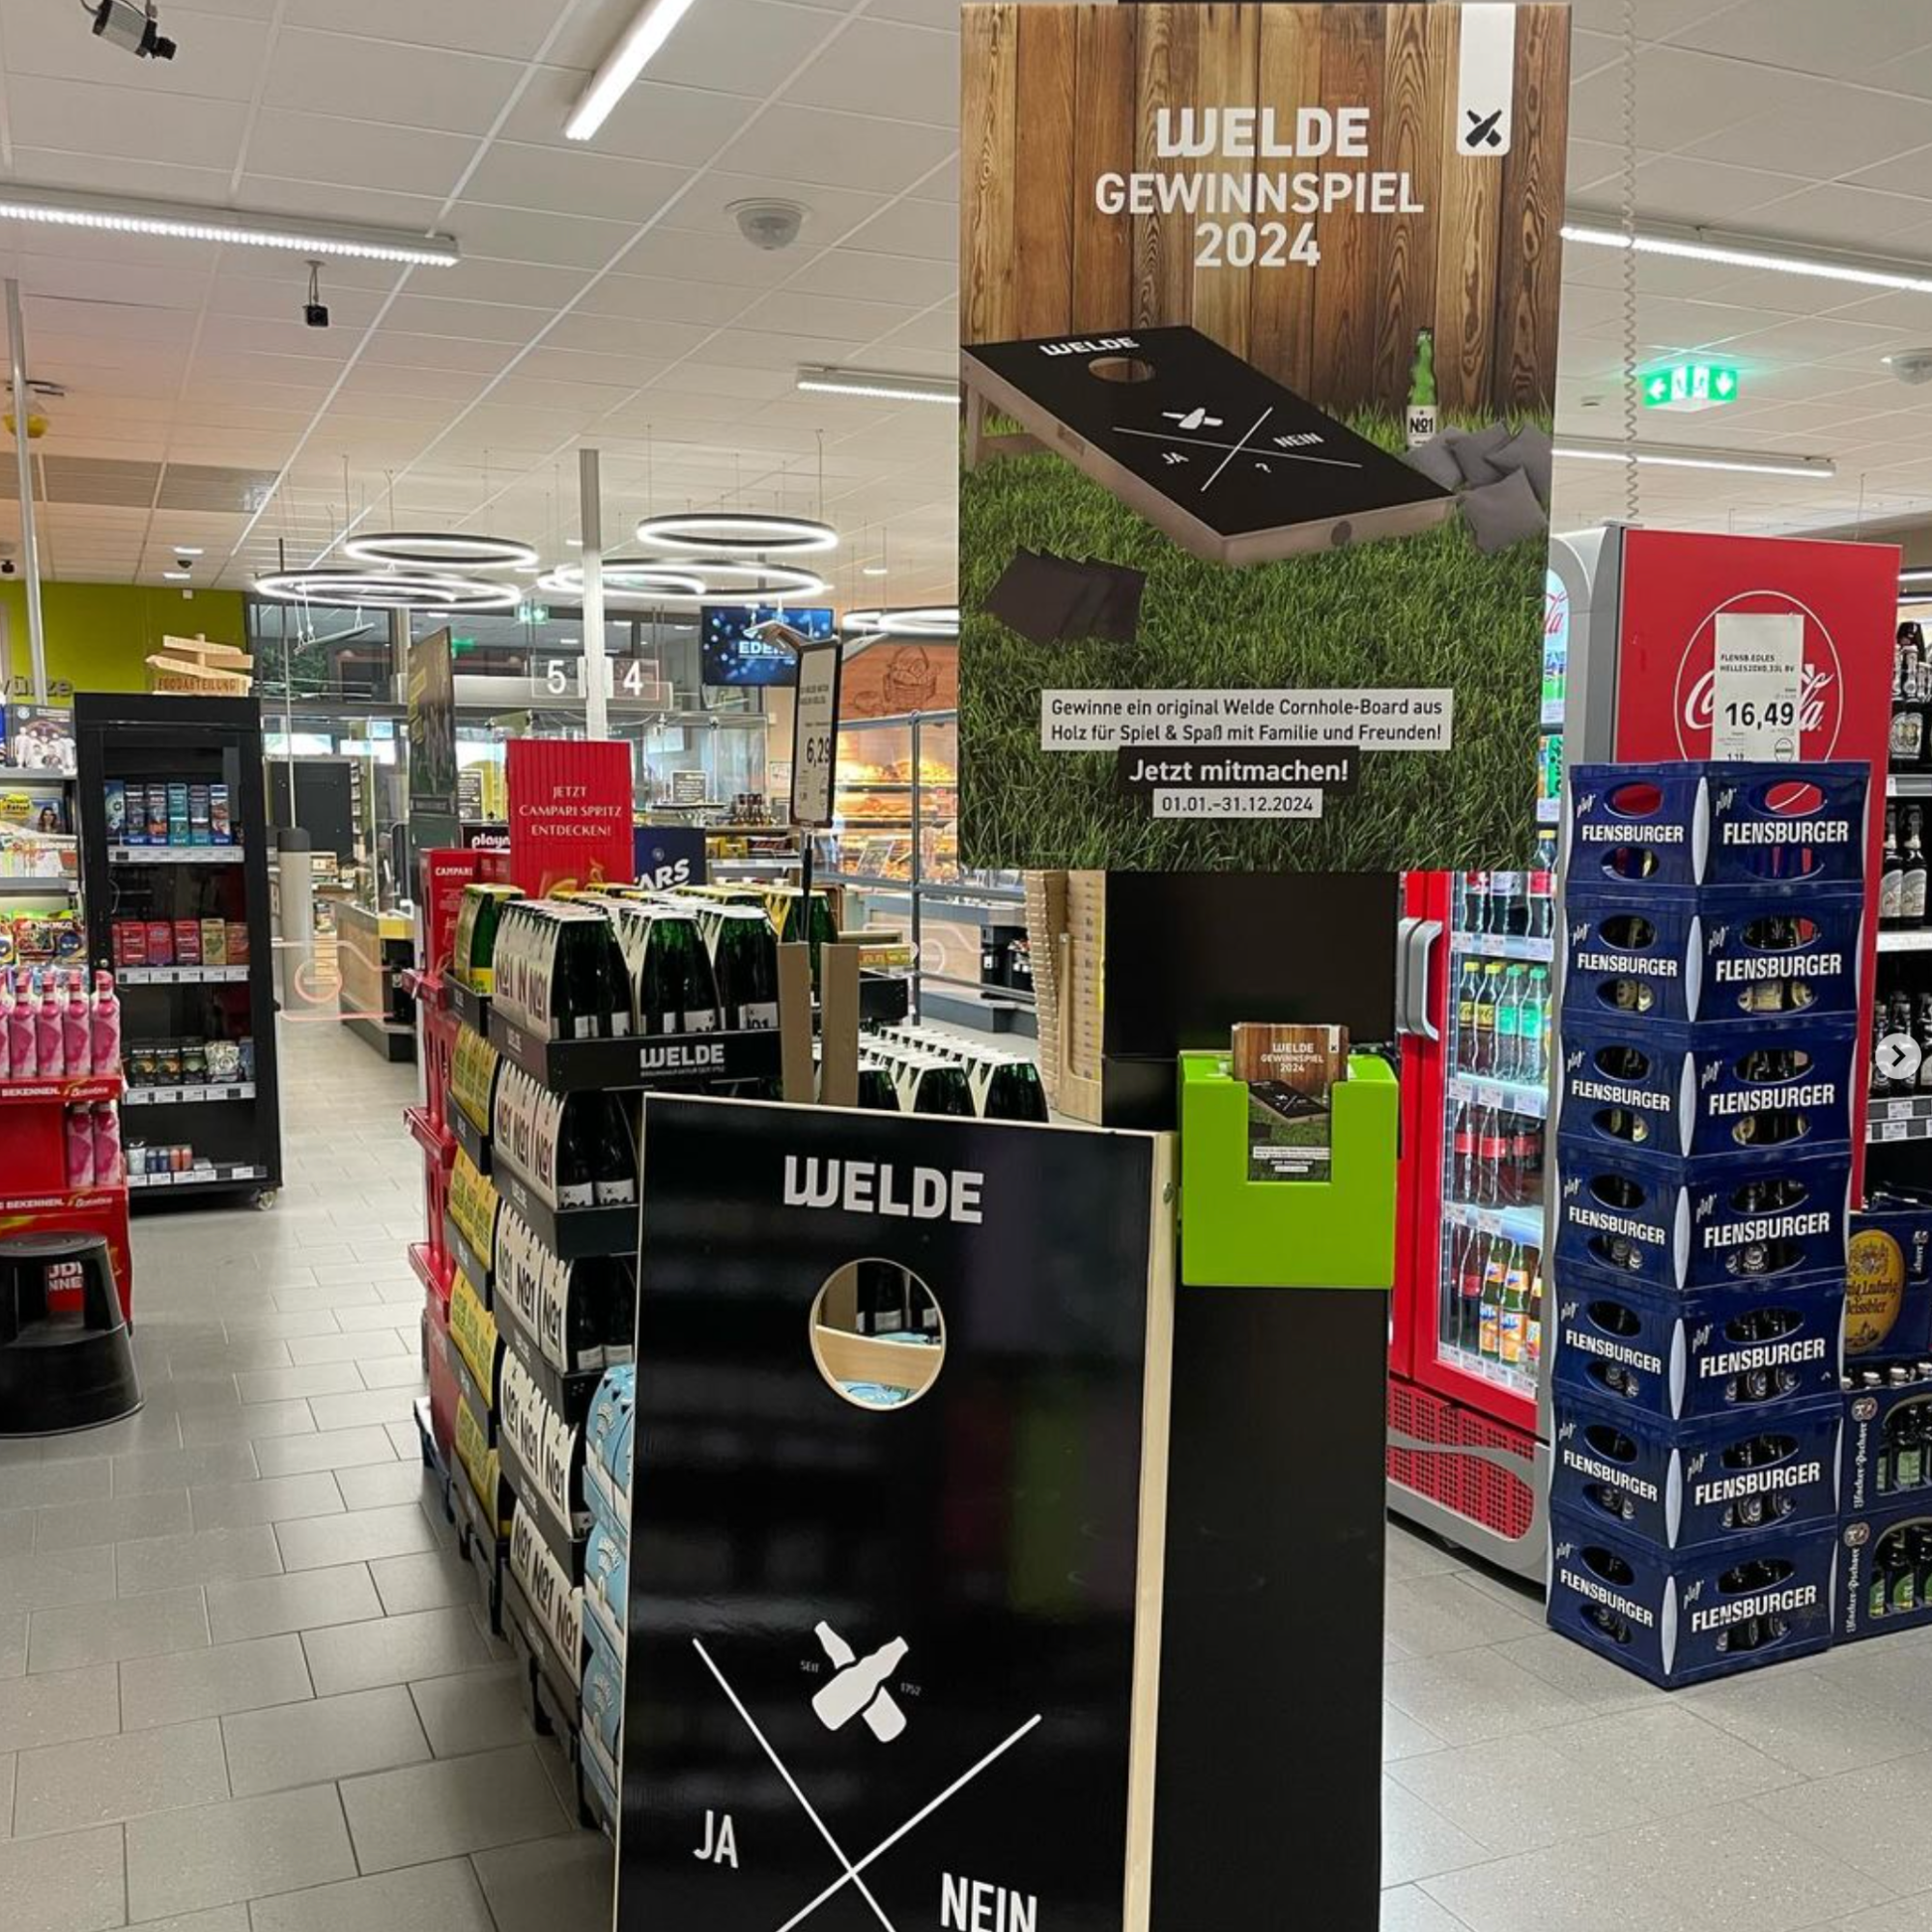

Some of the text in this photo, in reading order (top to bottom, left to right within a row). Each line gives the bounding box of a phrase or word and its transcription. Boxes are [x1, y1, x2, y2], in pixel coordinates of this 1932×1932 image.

[1156, 107, 1370, 157] WELDE
[1094, 172, 1425, 214] GEWINNSPIEL
[1194, 221, 1321, 268] 2024
[1039, 336, 1140, 356] WELDE
[1162, 451, 1188, 466] JA
[1272, 431, 1324, 450] NEIN
[547, 660, 565, 696] 5
[623, 661, 644, 696] 4
[1051, 698, 1443, 719] Gewinne ein original Welde Cornhole-Board aus
[1724, 701, 1795, 731] 16,49
[1051, 724, 1442, 744] Holz für Spiel & Spaß mit Familie und Freunden!
[806, 737, 830, 768] 6,29
[1129, 758, 1349, 782] Jetzt mitmachen!
[552, 785, 587, 800] JETZT
[518, 805, 622, 818] CAMPARI SPRITZ
[531, 825, 611, 838] ENTDECKEN!
[1581, 824, 1684, 842] FLENSBURGER
[1722, 820, 1849, 845] FLENSBURGER
[435, 866, 473, 876] CAMPARI
[633, 858, 691, 891] ARS
[1577, 952, 1678, 978] FLENSBURGER
[1716, 953, 1842, 982] FLENSBURGER
[639, 1043, 725, 1068] WELDE
[1260, 1053, 1324, 1065] GEWINNSPIEL
[1271, 1042, 1315, 1054] WELDE
[1279, 1063, 1306, 1073] 2024
[1572, 1079, 1670, 1112] FLENSBURGER
[1709, 1083, 1835, 1116] FLENSBURGER
[782, 1154, 984, 1225] WELDE
[1568, 1206, 1666, 1246] FLENSBURGER
[1703, 1211, 1831, 1248] FLENSBURGER
[1565, 1329, 1662, 1376] FLENSBURGER
[1699, 1337, 1827, 1378] FLENSBURGER
[1563, 1449, 1659, 1502] FLENSBURGER
[1694, 1462, 1822, 1506] FLENSBURGER
[1559, 1569, 1654, 1629] FLENSBURGER
[1691, 1584, 1817, 1633] FLENSBURGER
[693, 1809, 739, 1869] JA
[940, 1871, 1038, 1932] NEIN
